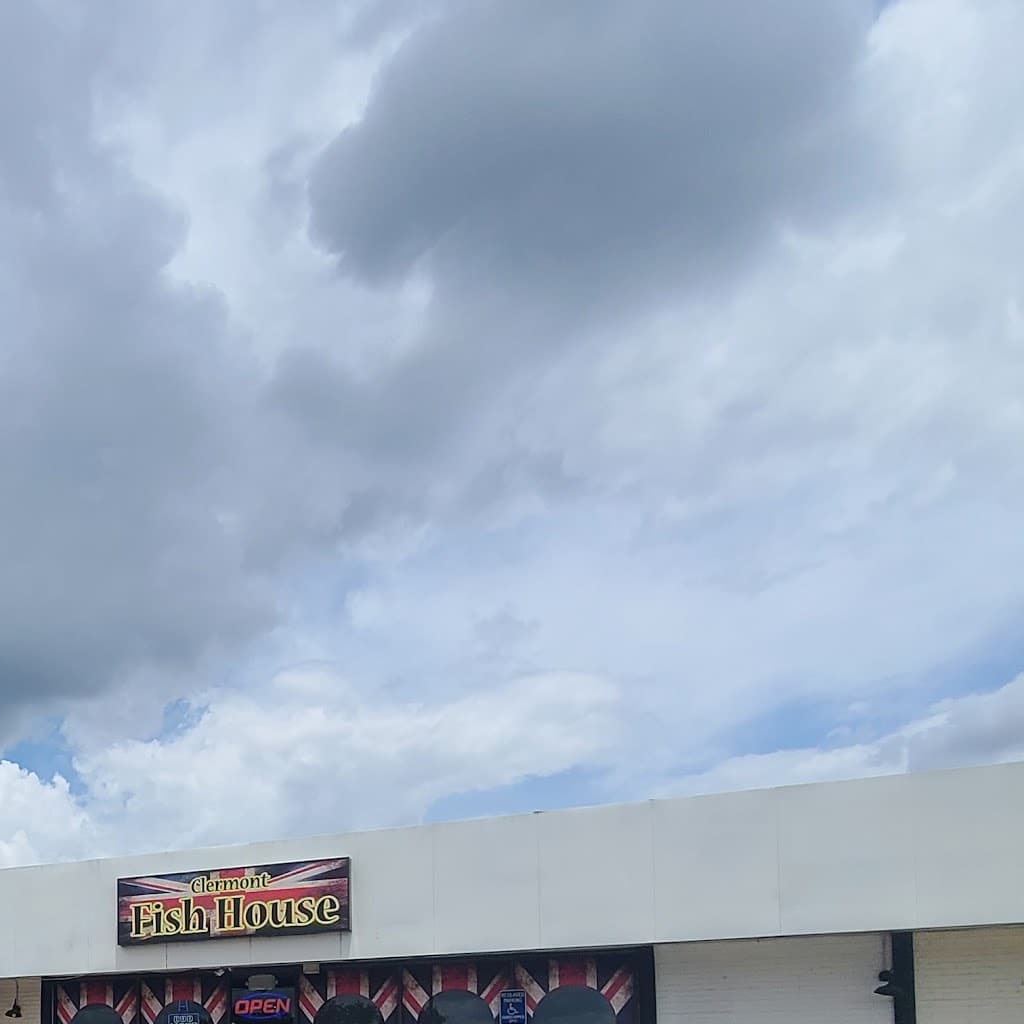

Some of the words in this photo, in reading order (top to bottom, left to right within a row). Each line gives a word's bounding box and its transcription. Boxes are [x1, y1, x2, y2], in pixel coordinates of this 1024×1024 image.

[190, 871, 271, 894] Clermont
[130, 896, 208, 938] Fish
[214, 895, 340, 932] House
[234, 998, 291, 1015] OPEN
